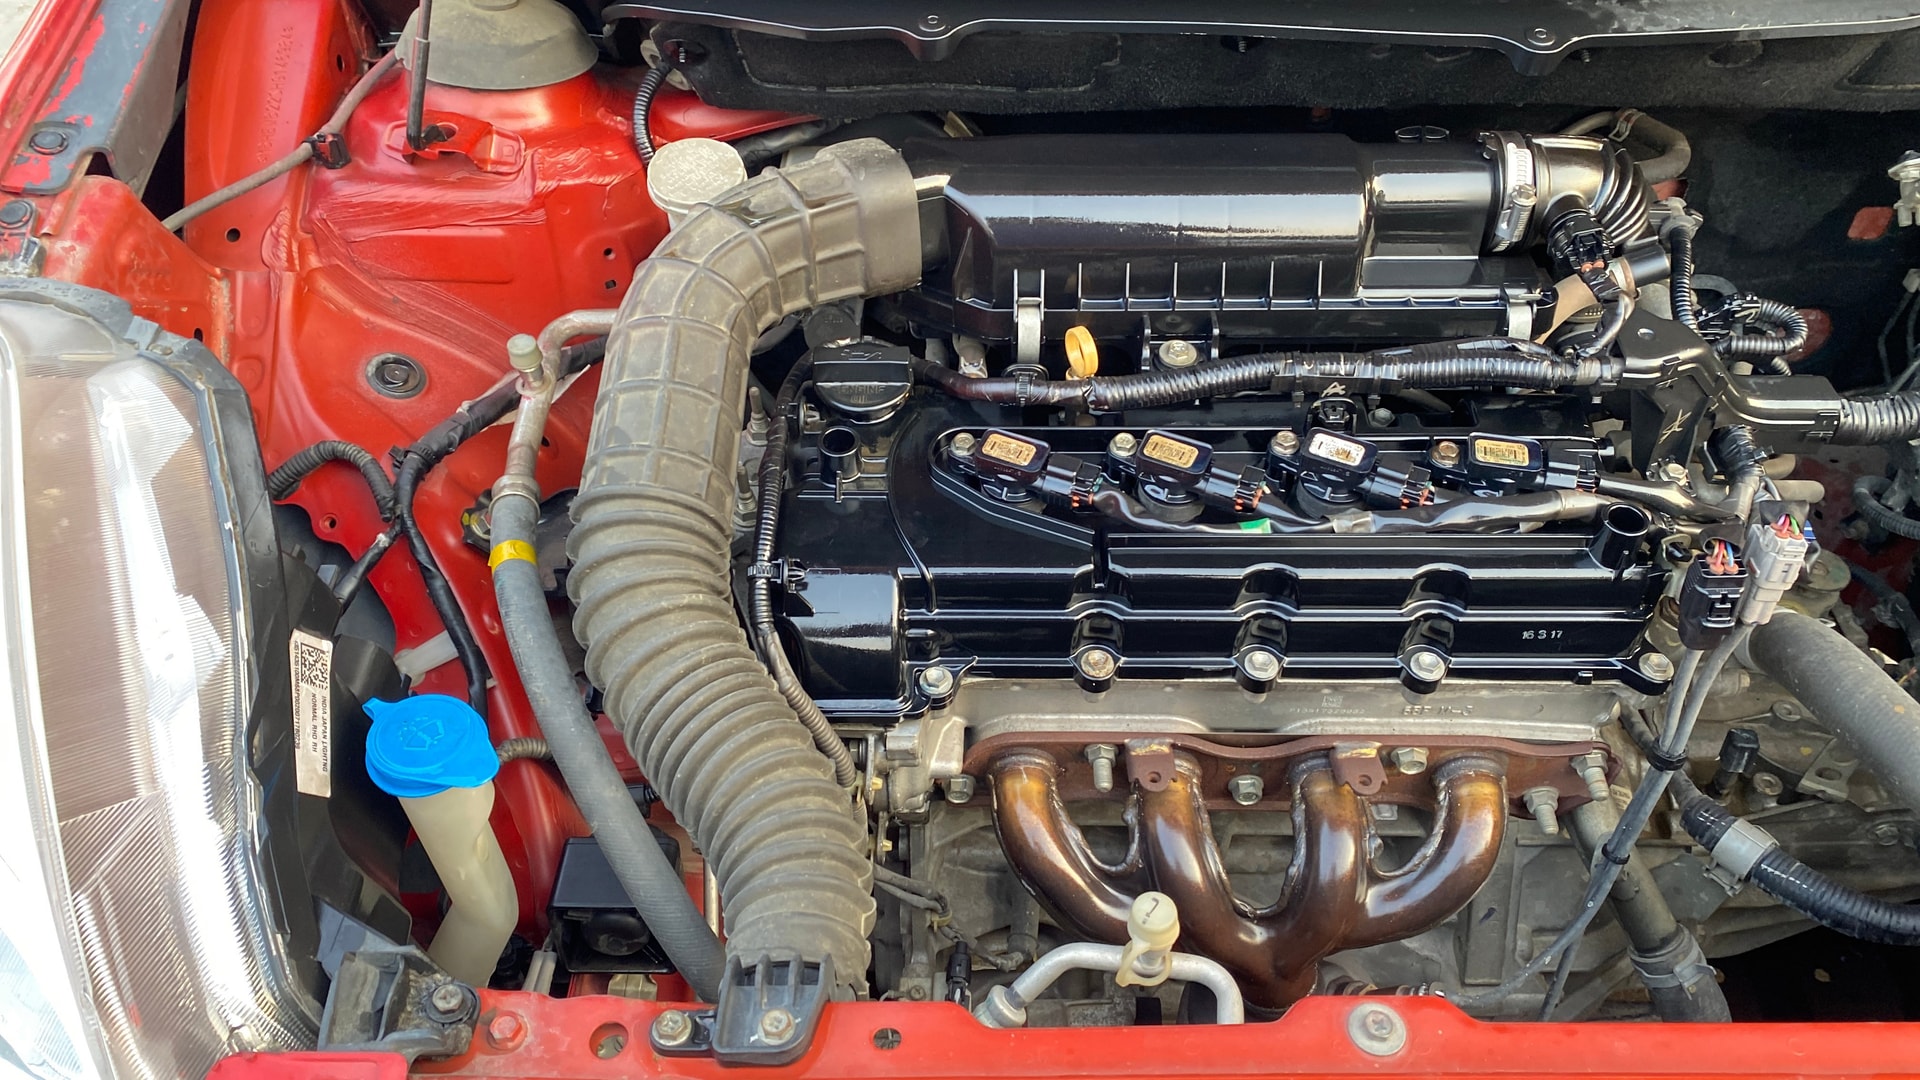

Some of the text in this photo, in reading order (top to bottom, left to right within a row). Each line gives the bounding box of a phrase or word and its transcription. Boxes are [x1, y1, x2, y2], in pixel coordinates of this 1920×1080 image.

[1521, 629, 1563, 640] 16 3 17
[311, 741, 318, 753] RH
